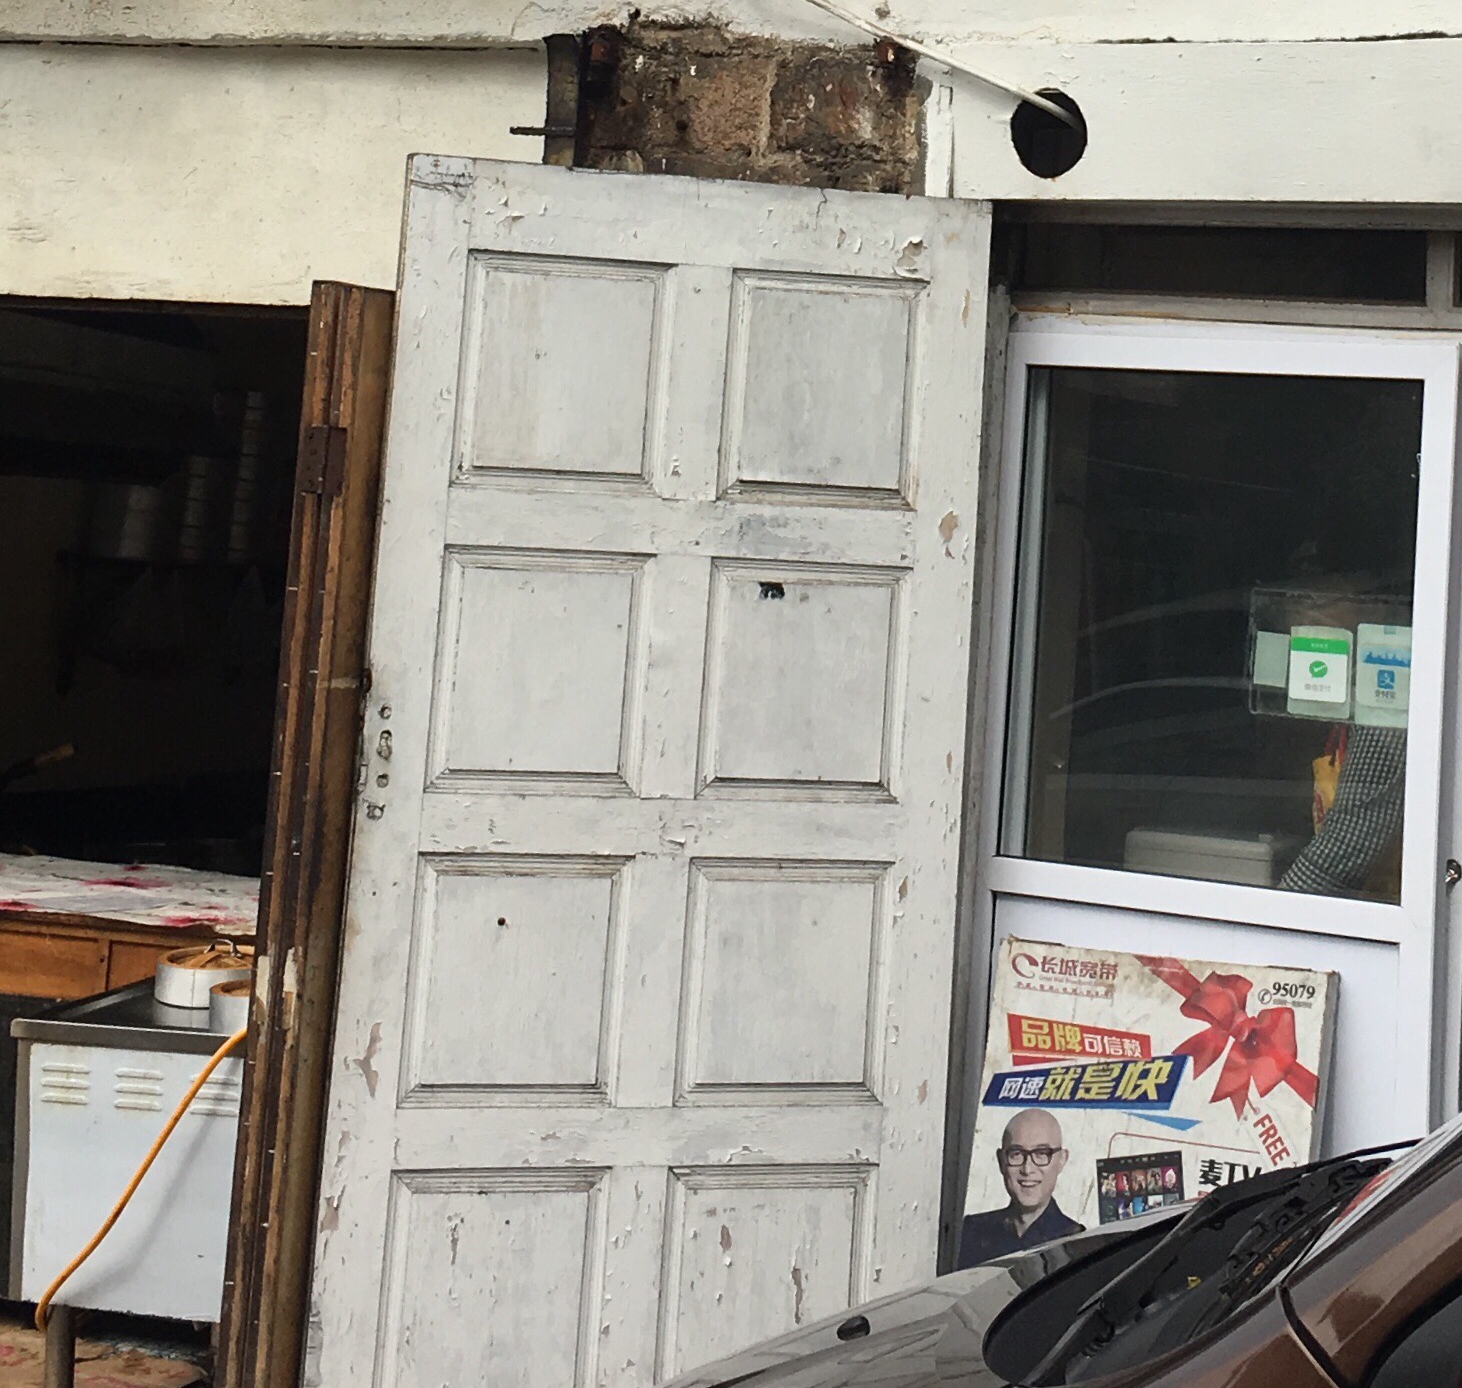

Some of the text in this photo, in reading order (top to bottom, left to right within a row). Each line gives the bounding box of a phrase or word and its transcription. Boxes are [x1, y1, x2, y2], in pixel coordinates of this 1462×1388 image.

[1041, 955, 1119, 981] 长城宽带
[1272, 981, 1316, 1000] 95079
[1021, 1018, 1143, 1059] 品牌可信赖
[998, 1059, 1173, 1101] 网速就是快
[1253, 1113, 1291, 1167] FREE
